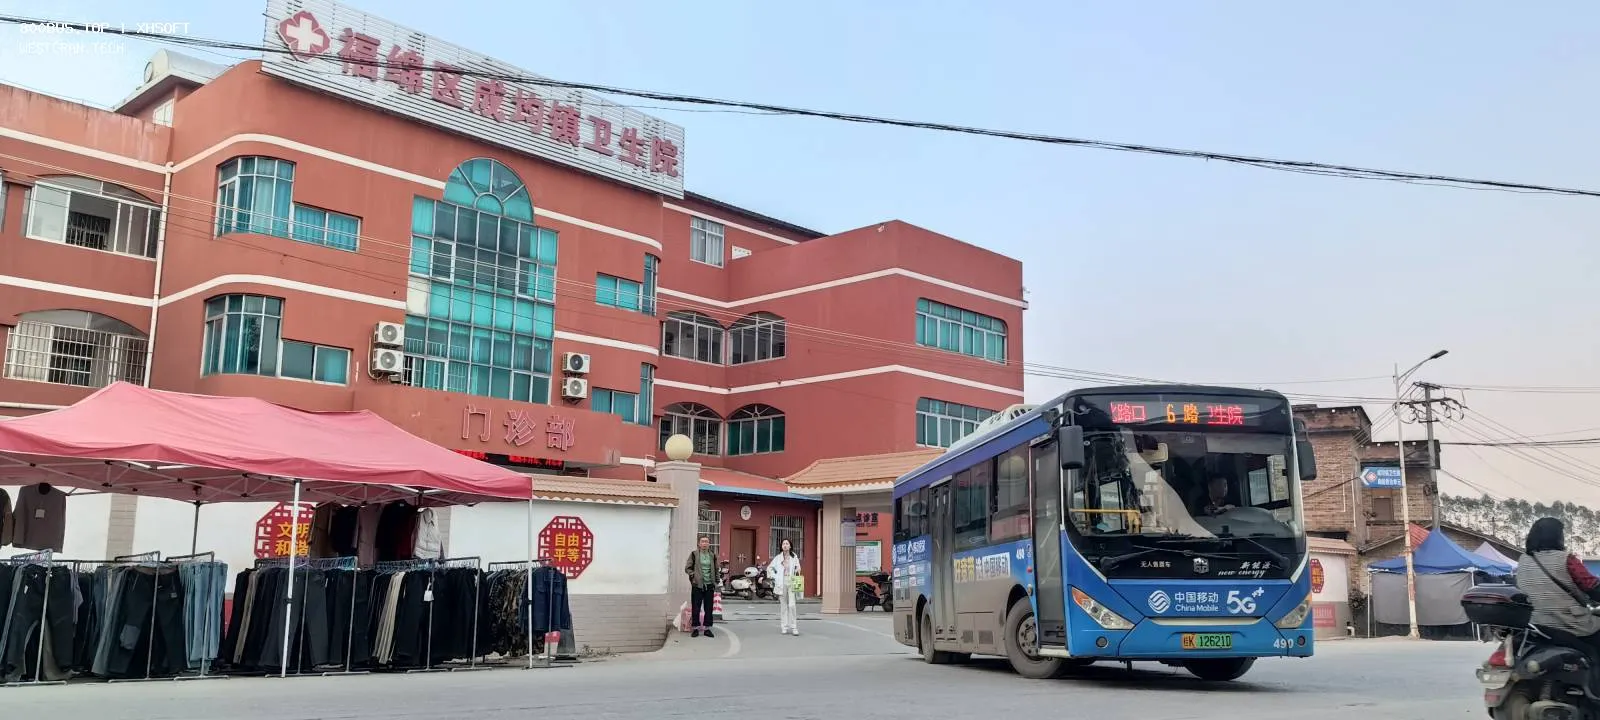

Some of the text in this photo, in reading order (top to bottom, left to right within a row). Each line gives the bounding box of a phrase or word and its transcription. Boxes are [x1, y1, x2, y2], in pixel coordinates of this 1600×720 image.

[338, 28, 679, 177] 福绵区成均镇卫生院
[1166, 403, 1176, 424] 6
[1183, 402, 1199, 424] 路
[462, 404, 575, 451] 门诊部
[277, 521, 310, 538] 文明
[555, 531, 580, 547] 自由
[274, 540, 309, 556] 和谐
[554, 547, 580, 563] 平等
[1238, 569, 1266, 578] energy
[1240, 561, 1270, 570] 新能源
[1174, 592, 1219, 603] 中国移动
[1175, 604, 1219, 612] China Mobile
[1273, 638, 1294, 649] 490
